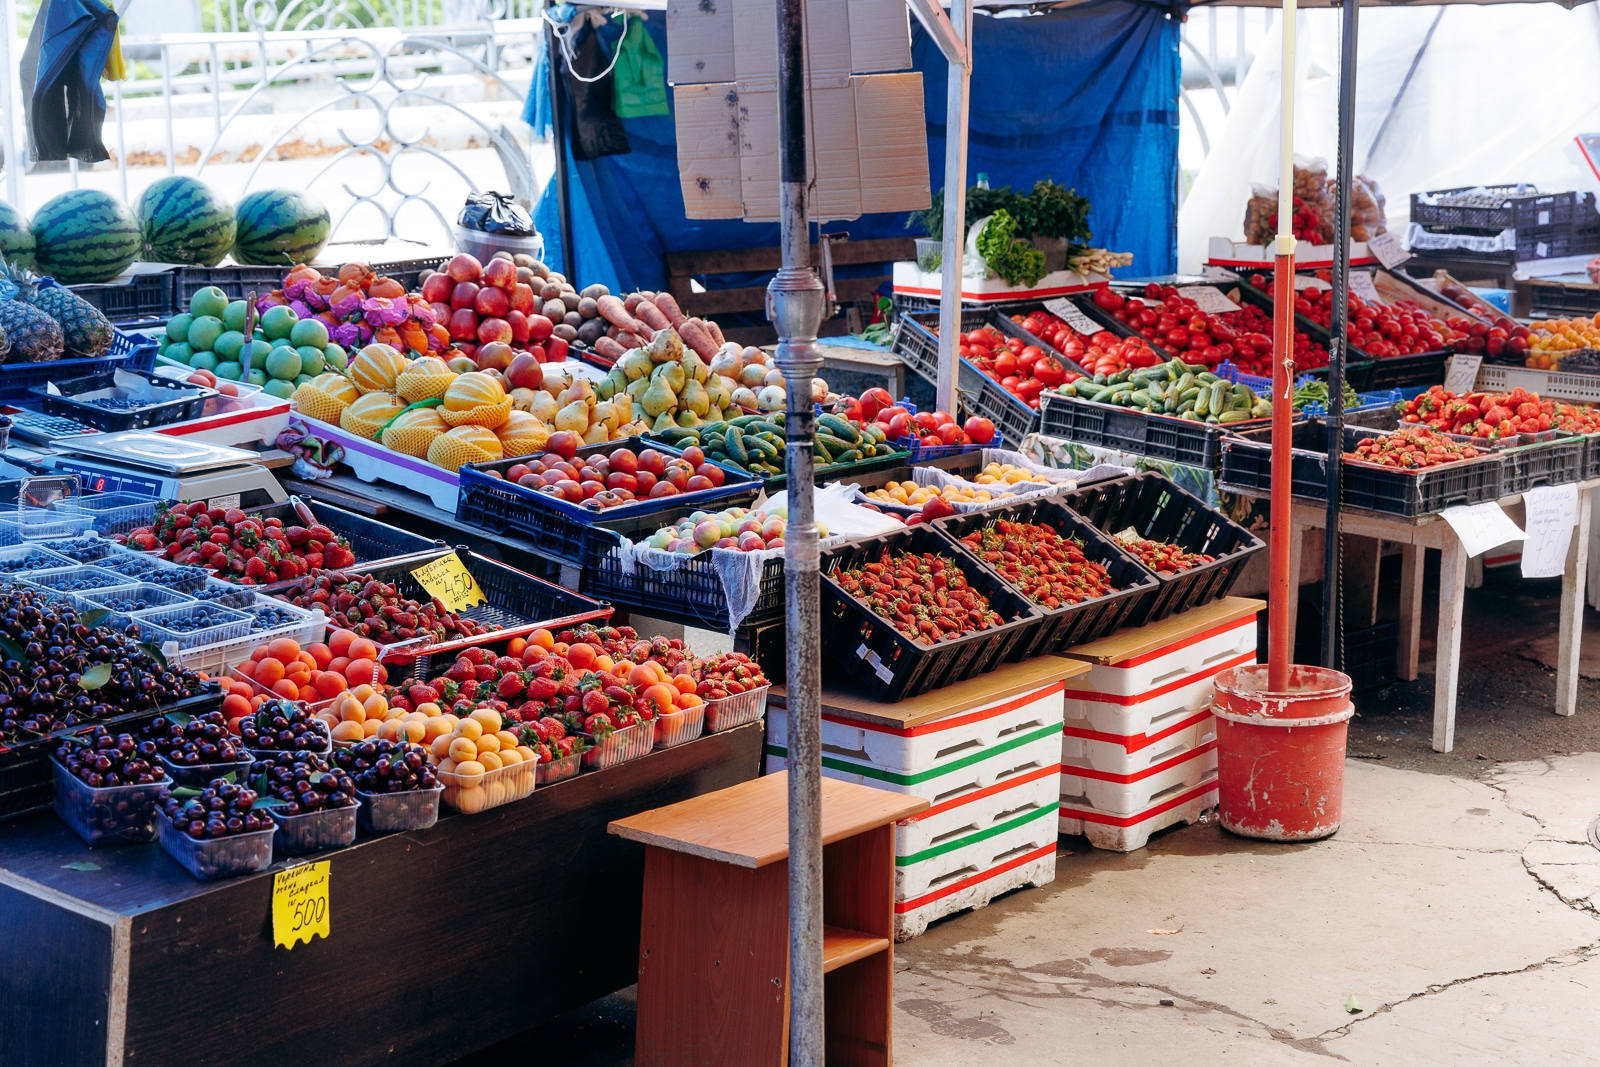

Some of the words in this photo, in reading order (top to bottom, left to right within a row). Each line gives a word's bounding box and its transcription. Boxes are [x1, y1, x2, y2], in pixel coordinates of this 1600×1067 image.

[444, 572, 472, 597] 450
[277, 863, 316, 886] Черешня
[275, 880, 297, 895] очень
[291, 896, 326, 932] 500
